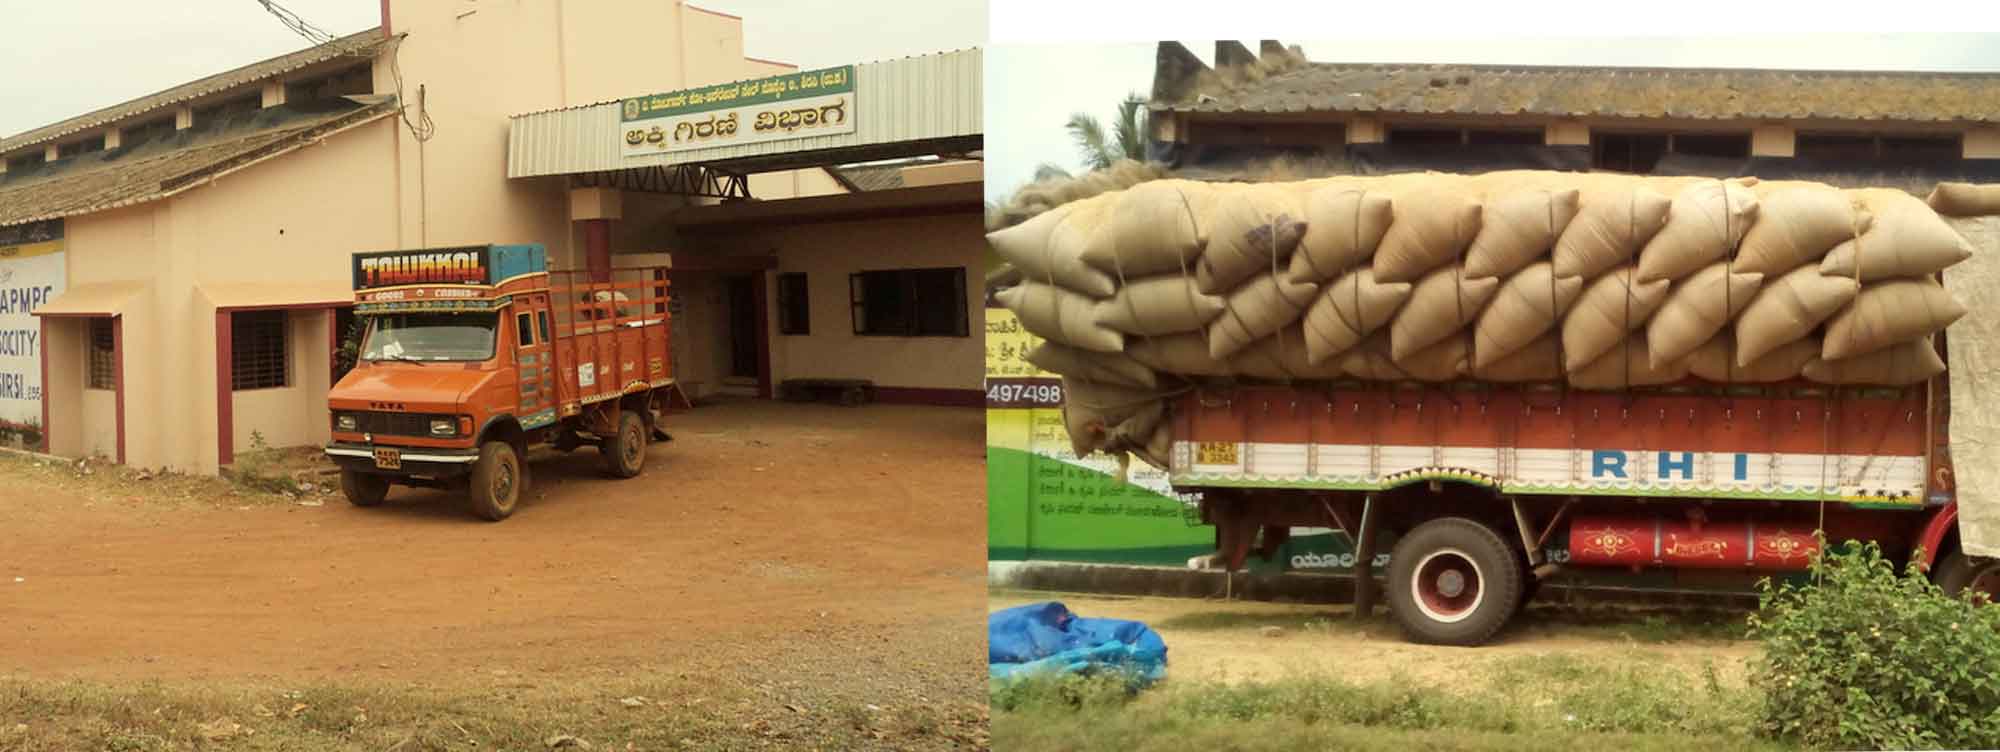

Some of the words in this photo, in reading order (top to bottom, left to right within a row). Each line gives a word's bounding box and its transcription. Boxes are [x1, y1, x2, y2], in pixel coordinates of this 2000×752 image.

[625, 124, 666, 149] ಅಕ್ಕಿ
[674, 111, 739, 142] ಗಿರಣಿ
[753, 97, 846, 133] ವಿಭಾಗ
[0, 329, 38, 357] OCITY
[986, 384, 1061, 402] 497498
